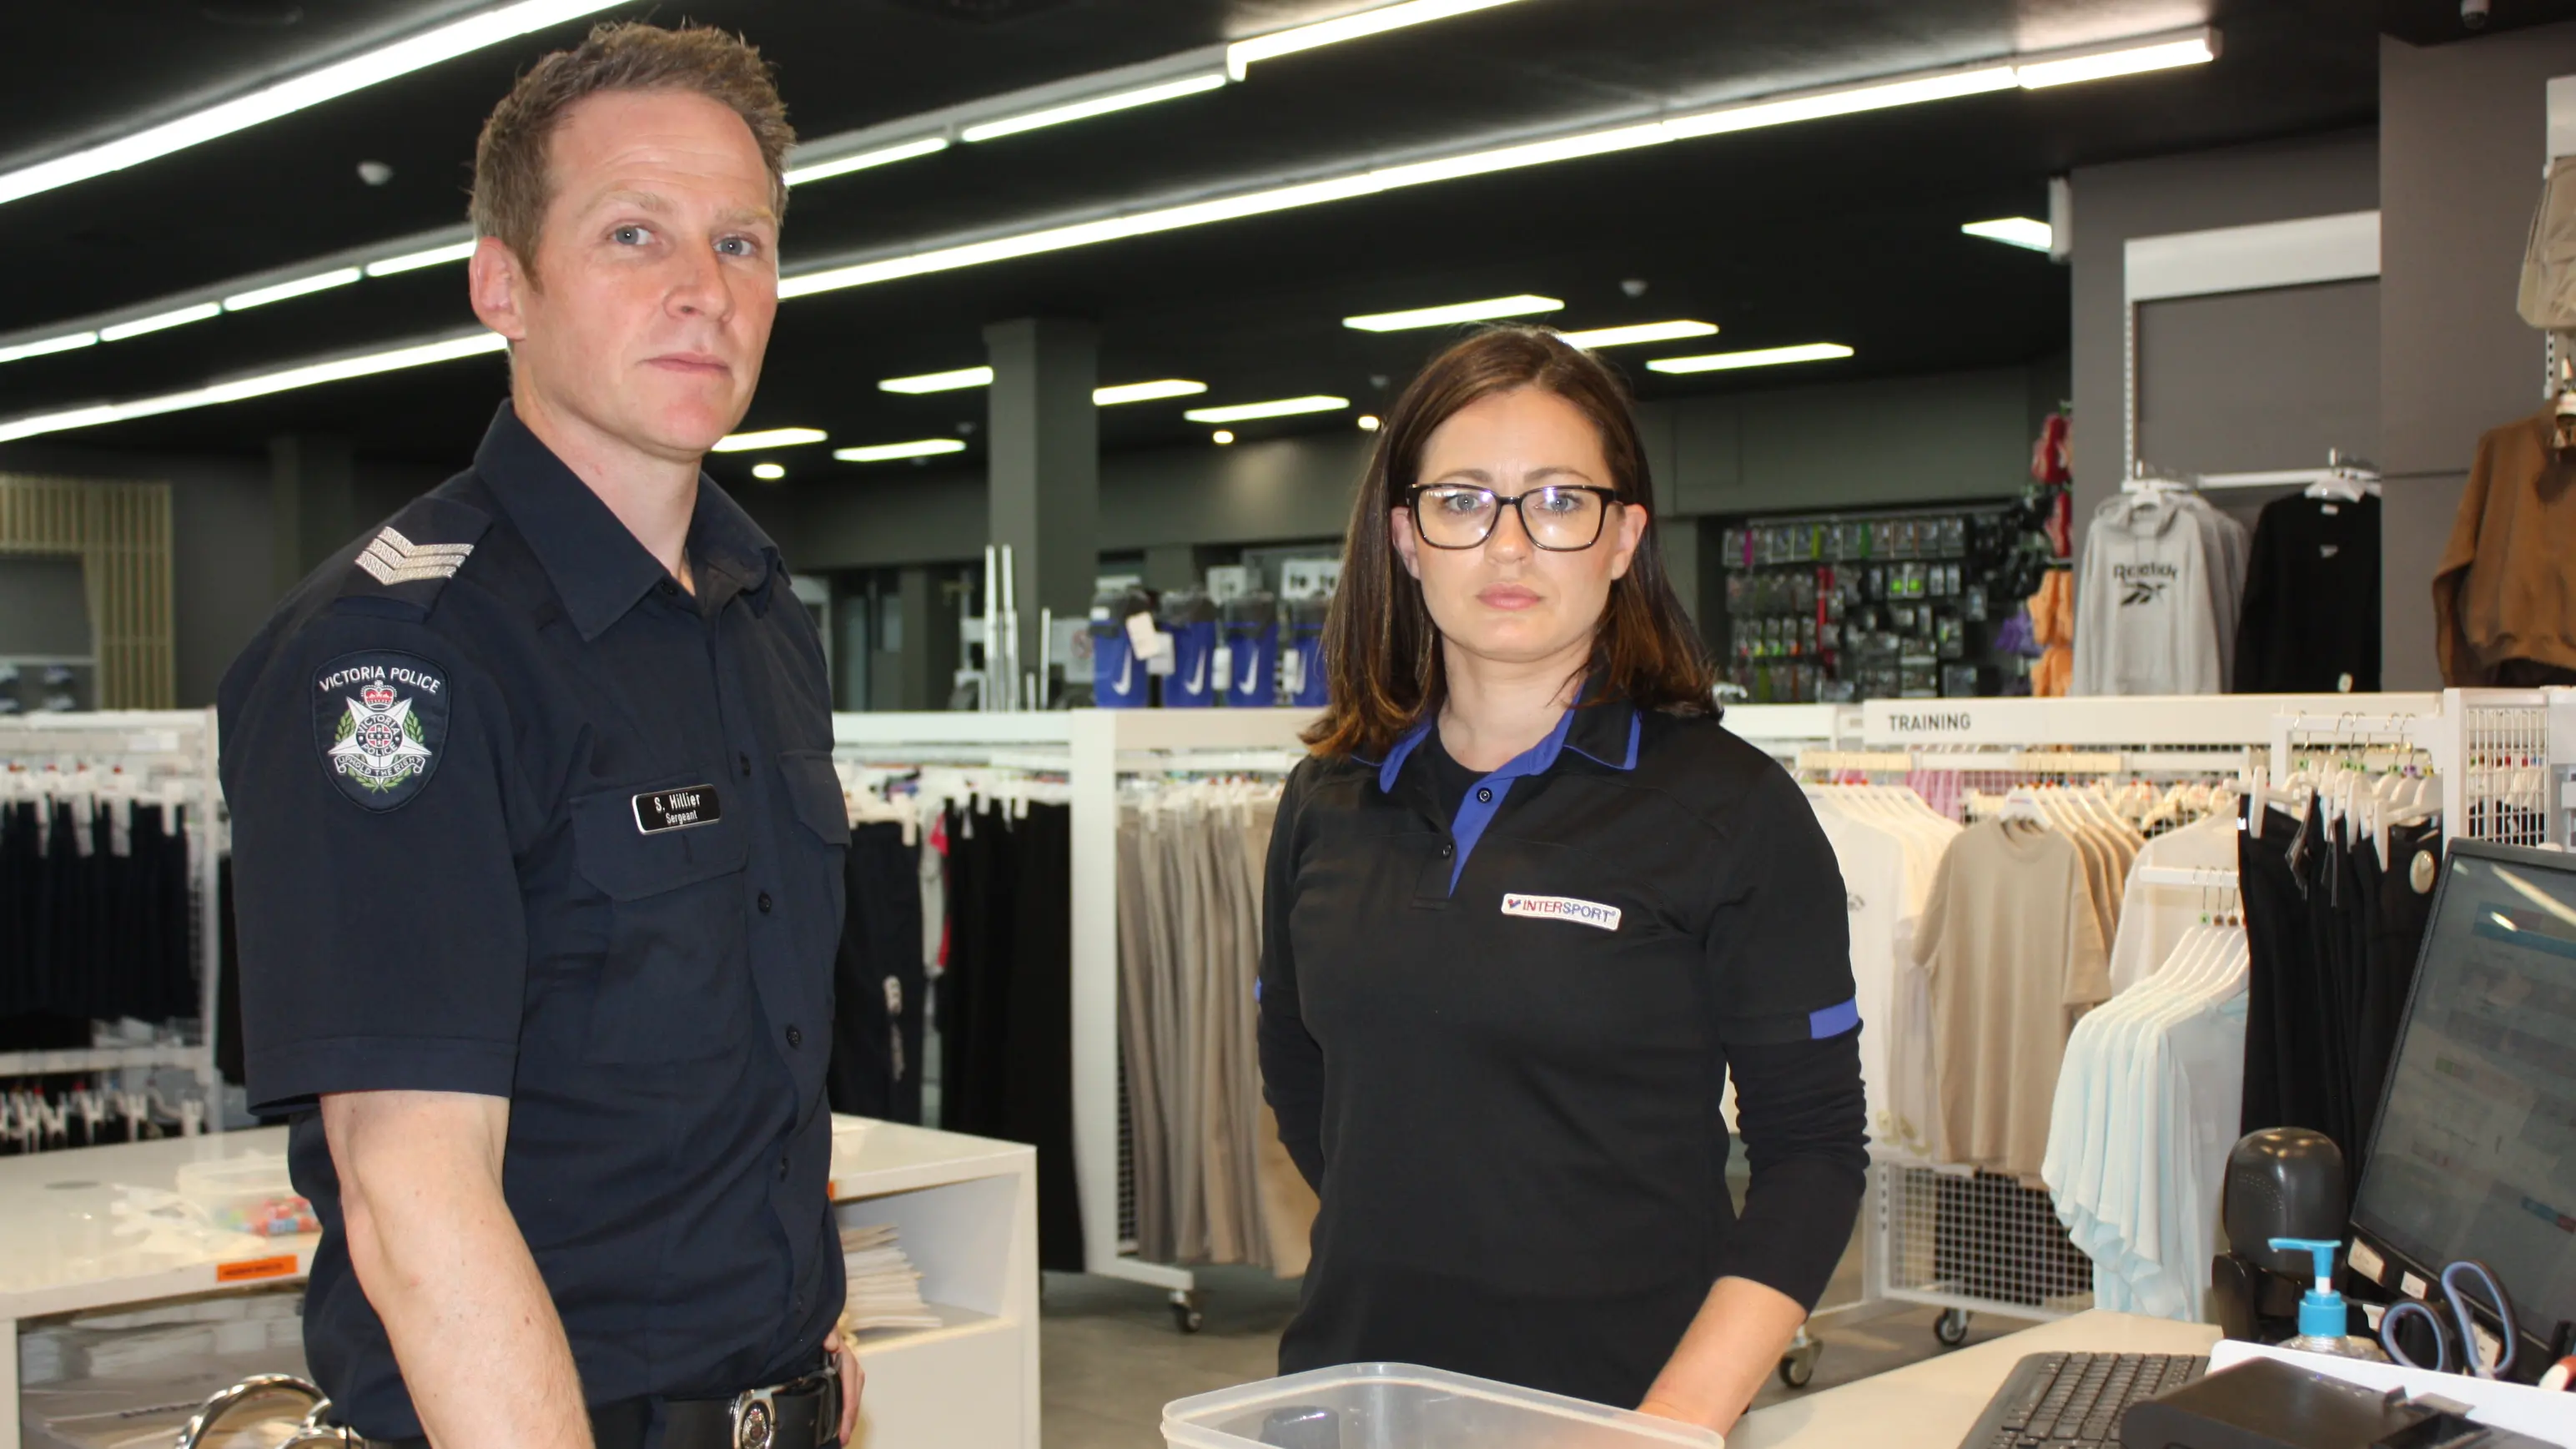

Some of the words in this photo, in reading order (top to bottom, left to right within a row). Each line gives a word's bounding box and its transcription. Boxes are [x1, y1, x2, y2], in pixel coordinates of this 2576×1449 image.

[319, 666, 385, 692] VICTORIA
[390, 667, 441, 694] POLICE
[358, 715, 400, 736] VICTORIA
[1889, 712, 1971, 731] TRAINING
[361, 741, 398, 756] POLICE
[338, 756, 372, 775] UPHOLD
[395, 757, 422, 772] RIGHT
[654, 797, 666, 813] S.
[669, 792, 701, 809] Hillier
[666, 809, 698, 824] Sergeant
